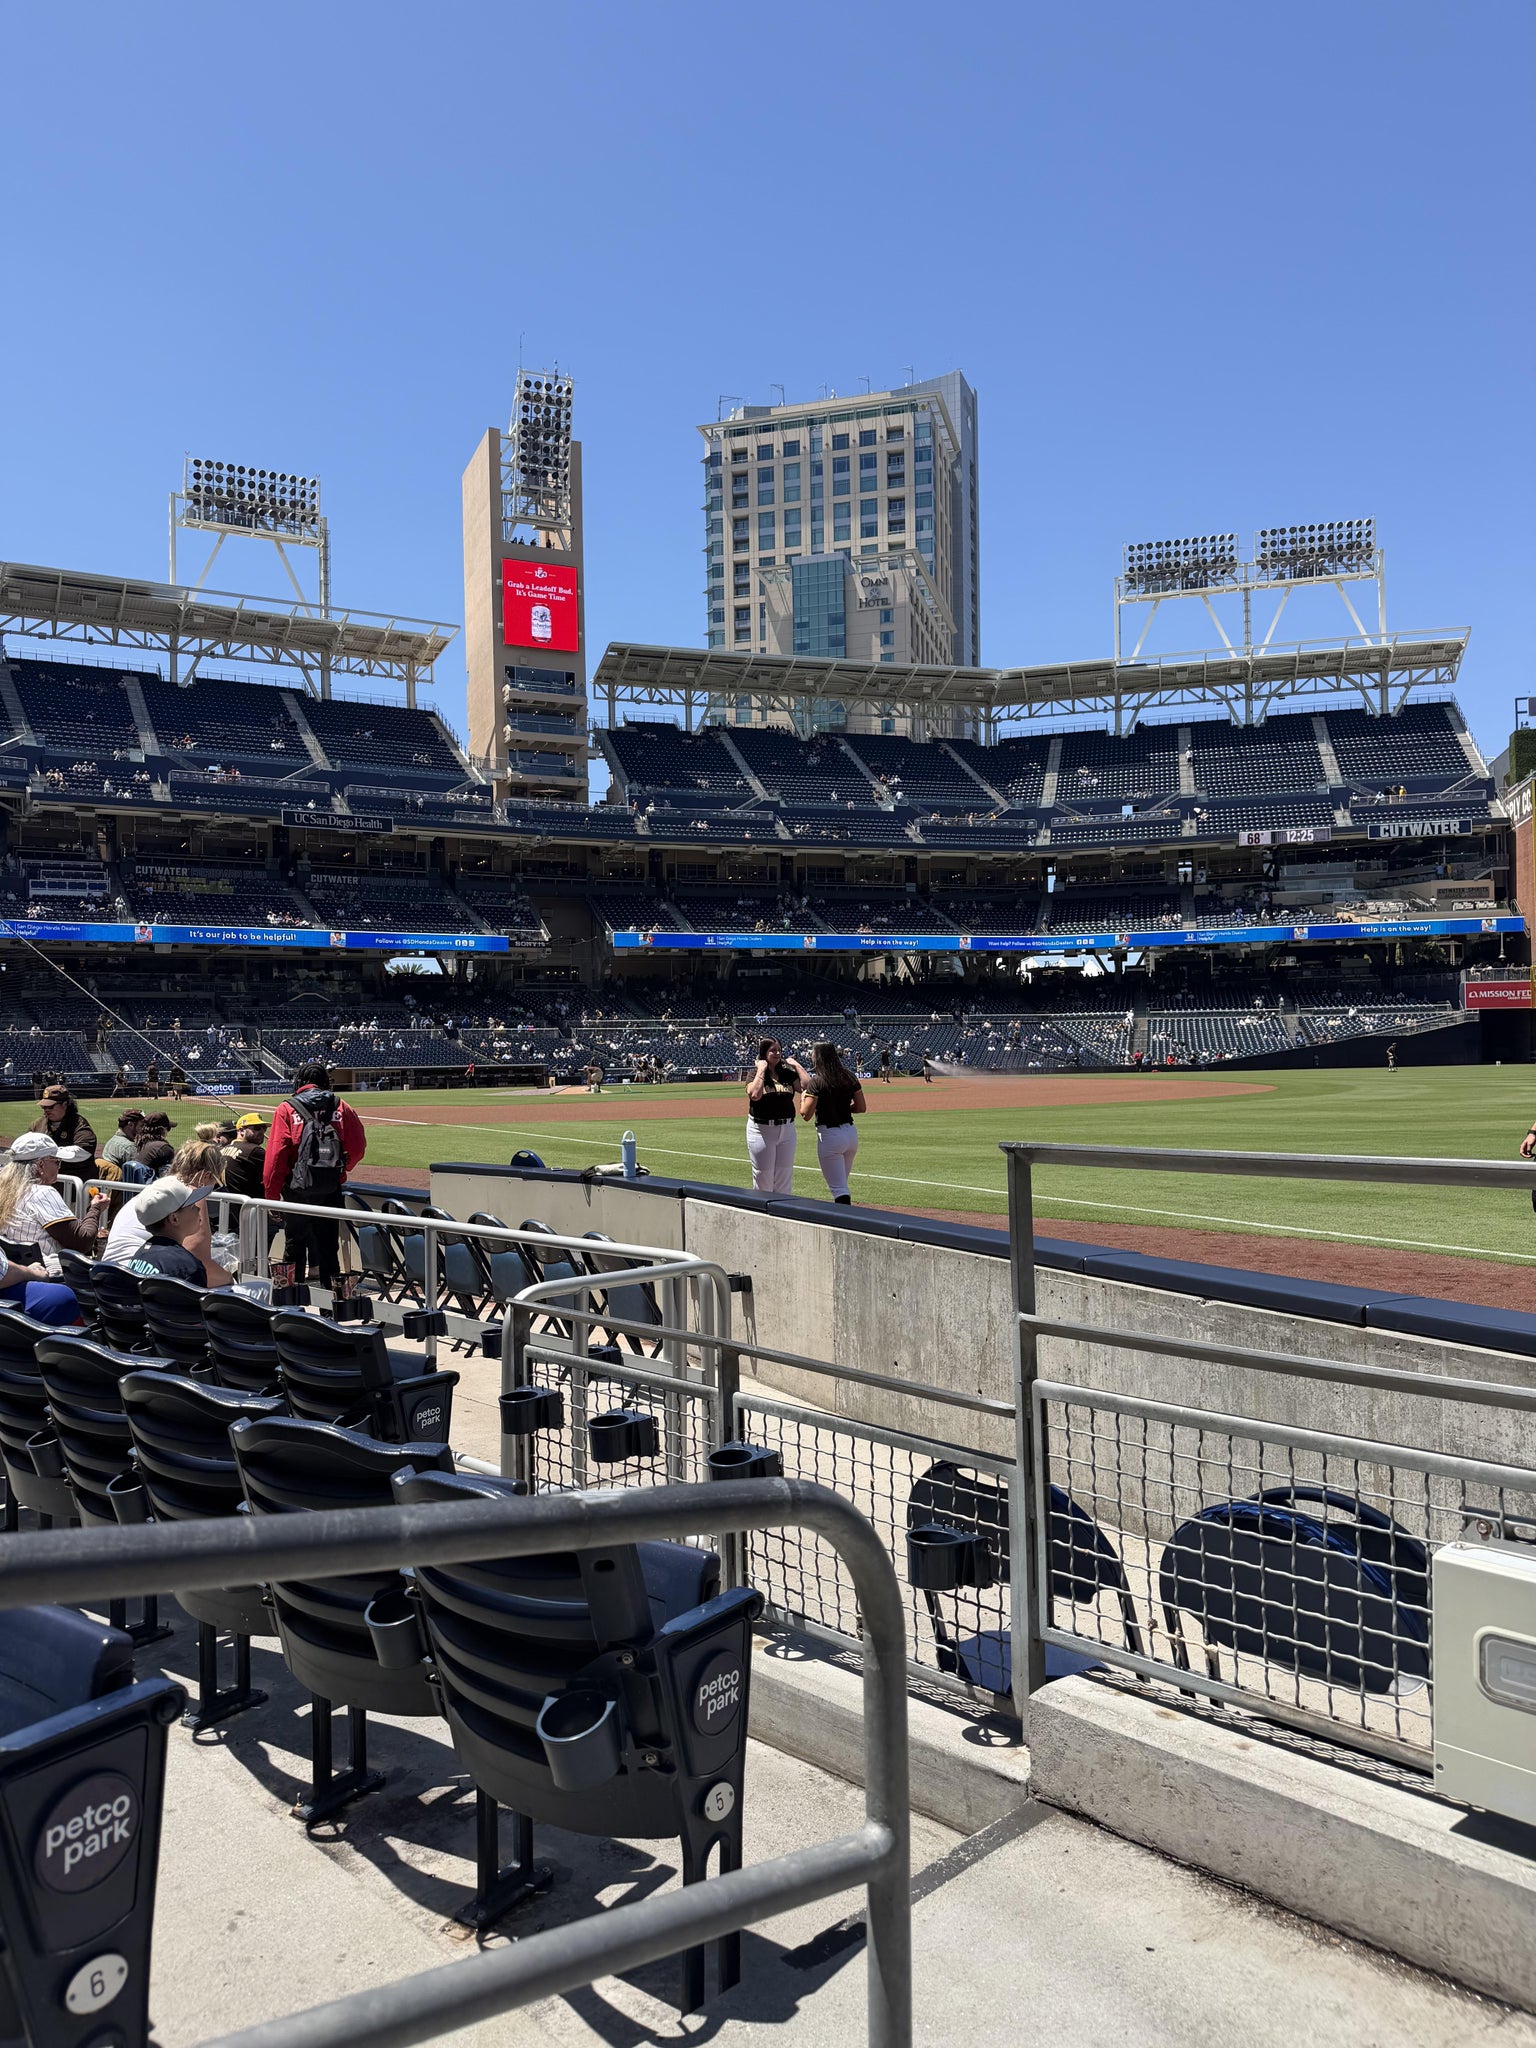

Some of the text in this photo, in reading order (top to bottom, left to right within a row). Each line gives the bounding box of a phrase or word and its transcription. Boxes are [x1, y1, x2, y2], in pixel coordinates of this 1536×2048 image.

[507, 581, 524, 589] Grab
[531, 584, 557, 593] Leadoff
[861, 577, 888, 587] OMNI
[516, 589, 566, 601] It's Game Time
[859, 597, 891, 608] HOTEL
[293, 813, 383, 829] UC San Diego Health
[1285, 829, 1314, 842] 12:25
[1379, 820, 1461, 838] CUTWATER
[135, 865, 188, 876] CUTWATER
[310, 874, 359, 885] CUTWATER
[1413, 925, 1431, 933] way!
[189, 930, 203, 938] It's
[222, 931, 236, 941] job
[250, 932, 261, 940] be
[263, 933, 297, 942] helpful!
[1480, 990, 1516, 998] MISSION
[208, 1084, 234, 1093] petco
[416, 1406, 441, 1422] petco
[421, 1415, 441, 1429] park
[699, 1669, 740, 1706] petco
[707, 1686, 739, 1720] park
[716, 1791, 724, 1811] 5
[46, 1794, 131, 1858] petco
[63, 1817, 131, 1875] park
[90, 1970, 105, 1998] 6
